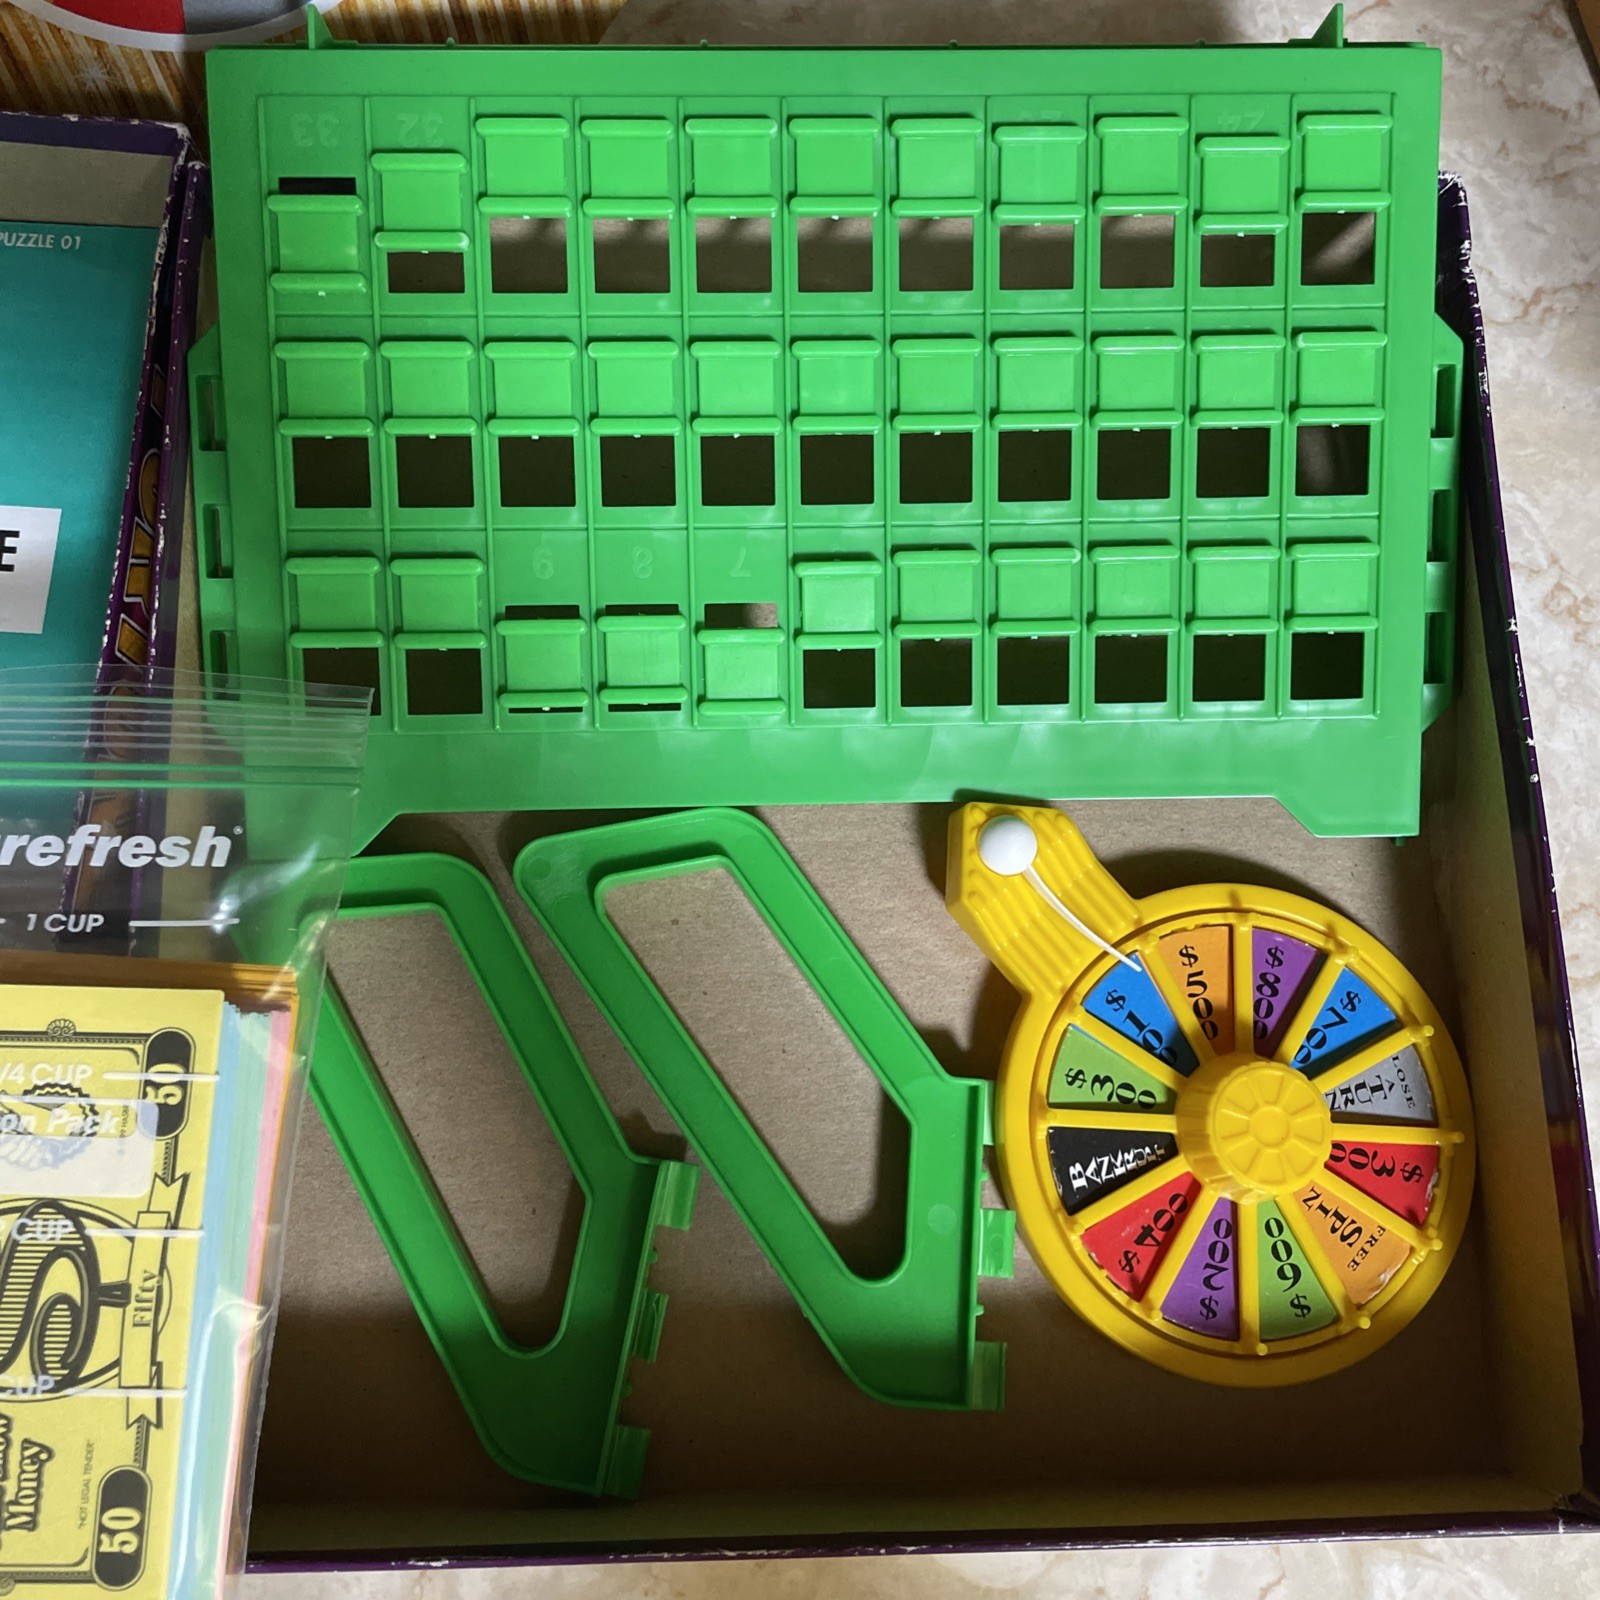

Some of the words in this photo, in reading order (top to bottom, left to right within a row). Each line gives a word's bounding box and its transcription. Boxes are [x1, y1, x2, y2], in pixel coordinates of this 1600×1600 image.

[61, 235, 81, 250] 01
[631, 545, 654, 580] 8
[729, 545, 751, 578] 7
[26, 913, 37, 931] 1
[44, 914, 105, 933] CUP
[1178, 944, 1219, 1041] $500
[1253, 946, 1284, 1040] $800
[1105, 989, 1178, 1065] $100
[1294, 990, 1362, 1065] $700
[31, 1062, 94, 1086] CUP
[145, 1062, 185, 1106] 50
[1064, 1067, 1157, 1110] $300
[1325, 1074, 1387, 1112] TURN
[1384, 1078, 1396, 1094] A
[1391, 1055, 1416, 1109] LOSE
[46, 1106, 120, 1135] Pack
[1331, 1142, 1424, 1184] $300
[11, 1218, 75, 1242] CUP
[1118, 1193, 1188, 1273] $400
[1302, 1187, 1364, 1248] SPIN
[1200, 1218, 1233, 1321] $200
[1264, 1217, 1312, 1319] $600
[1347, 1225, 1387, 1272] FREE
[132, 1269, 162, 1328] Fifty
[5, 1439, 53, 1532] Money
[80, 1478, 91, 1505] LEGAL
[98, 1506, 142, 1555] 50
